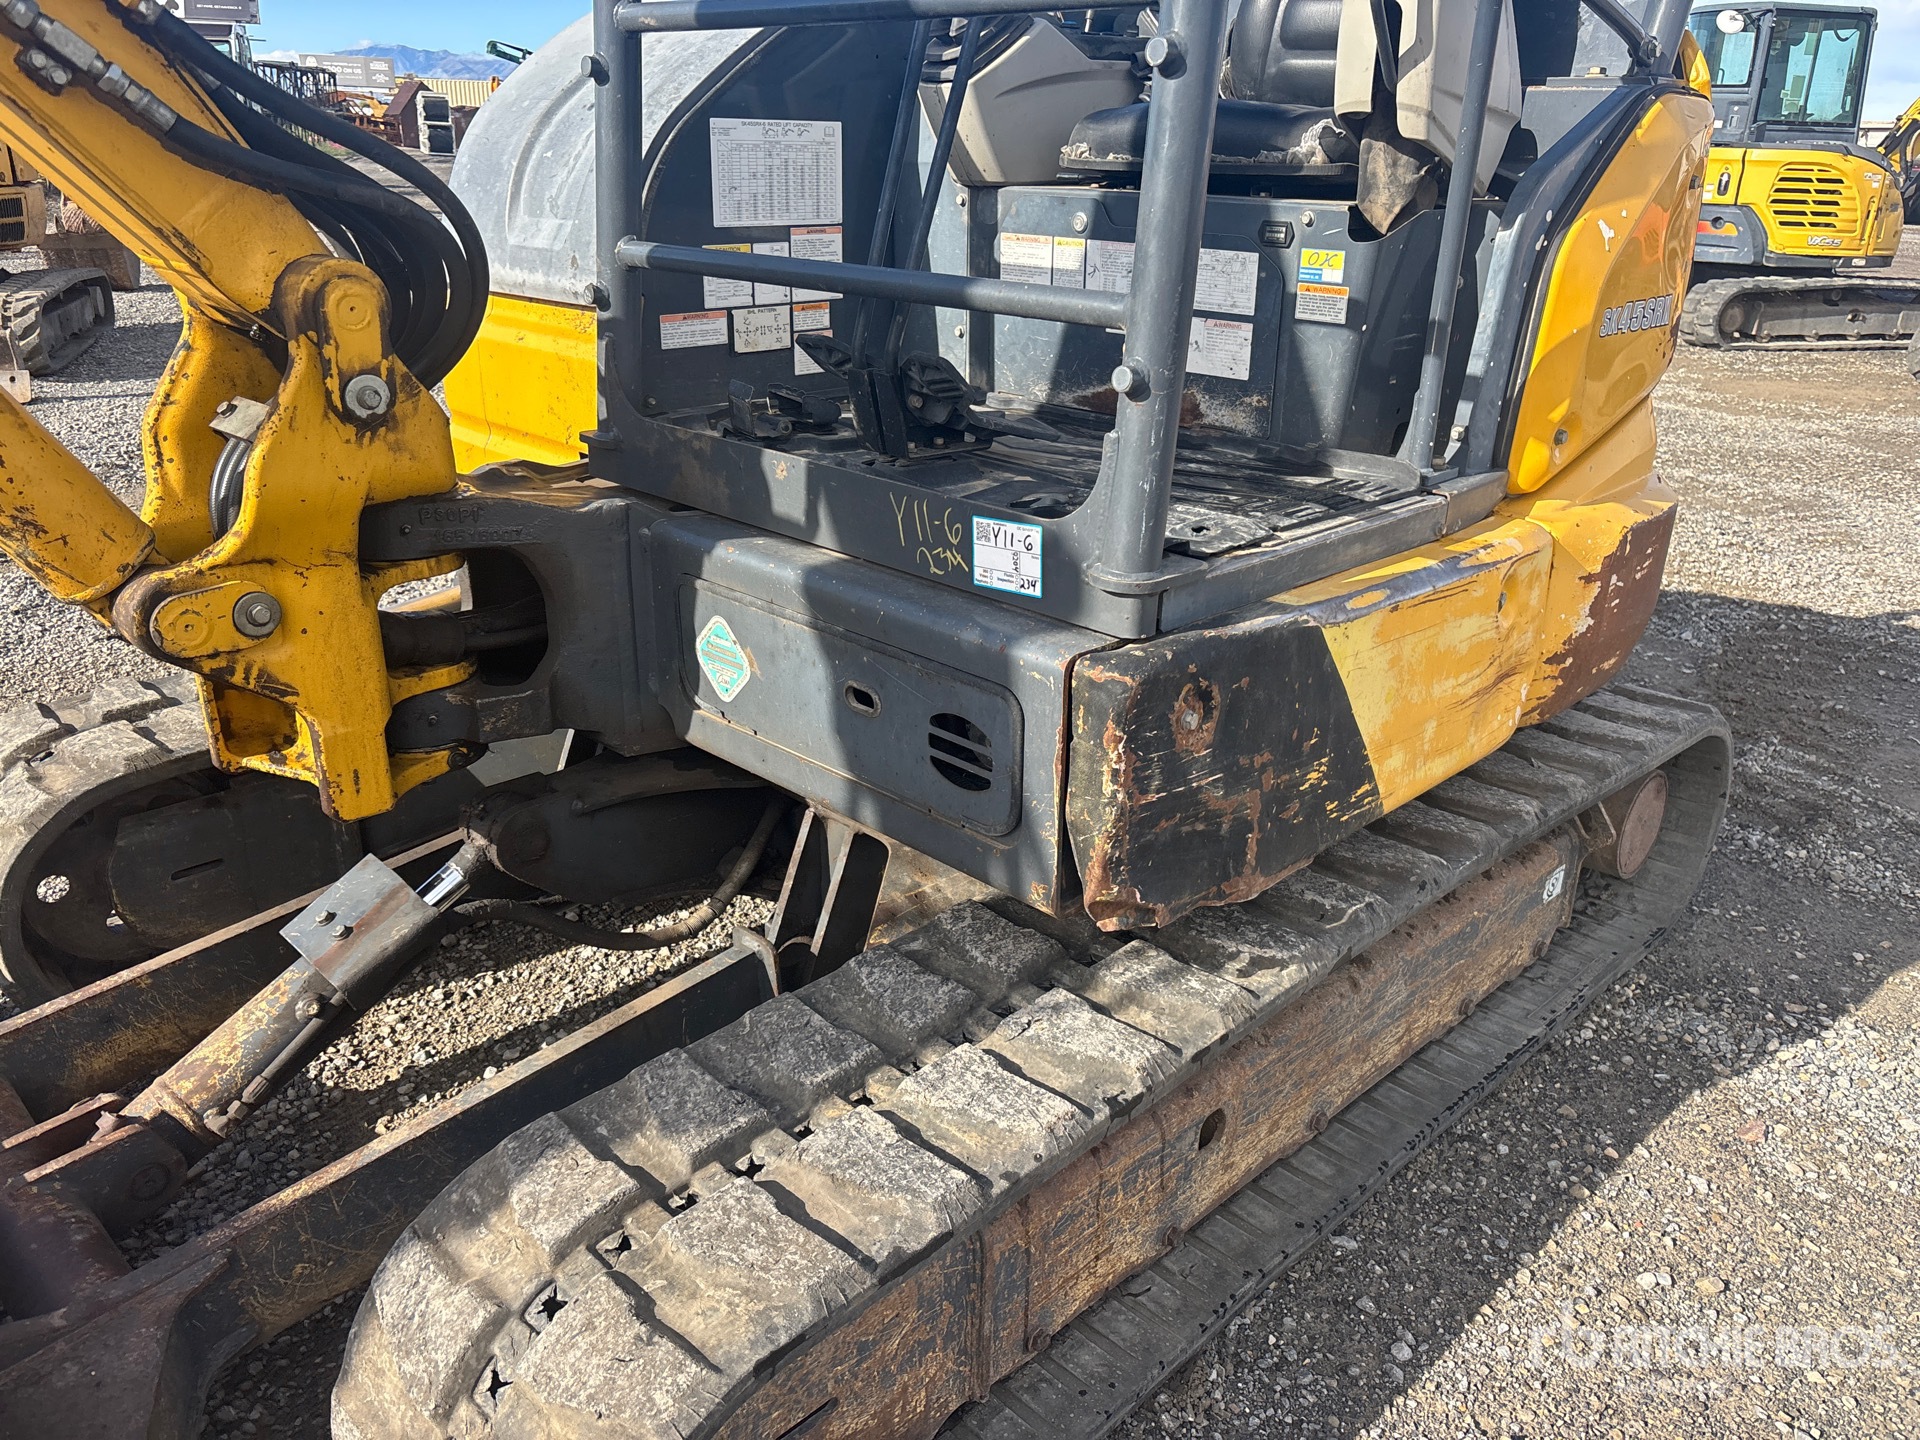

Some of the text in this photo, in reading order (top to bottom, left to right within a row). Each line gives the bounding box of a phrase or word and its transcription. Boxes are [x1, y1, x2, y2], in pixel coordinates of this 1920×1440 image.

[1308, 251, 1338, 267] OK
[1313, 286, 1342, 295] WARNING
[1599, 293, 1674, 338] SK45SRX
[889, 491, 962, 547] Y11-6
[992, 526, 1034, 552] Y11-6
[917, 546, 969, 575] 234
[1020, 577, 1037, 593] 234
